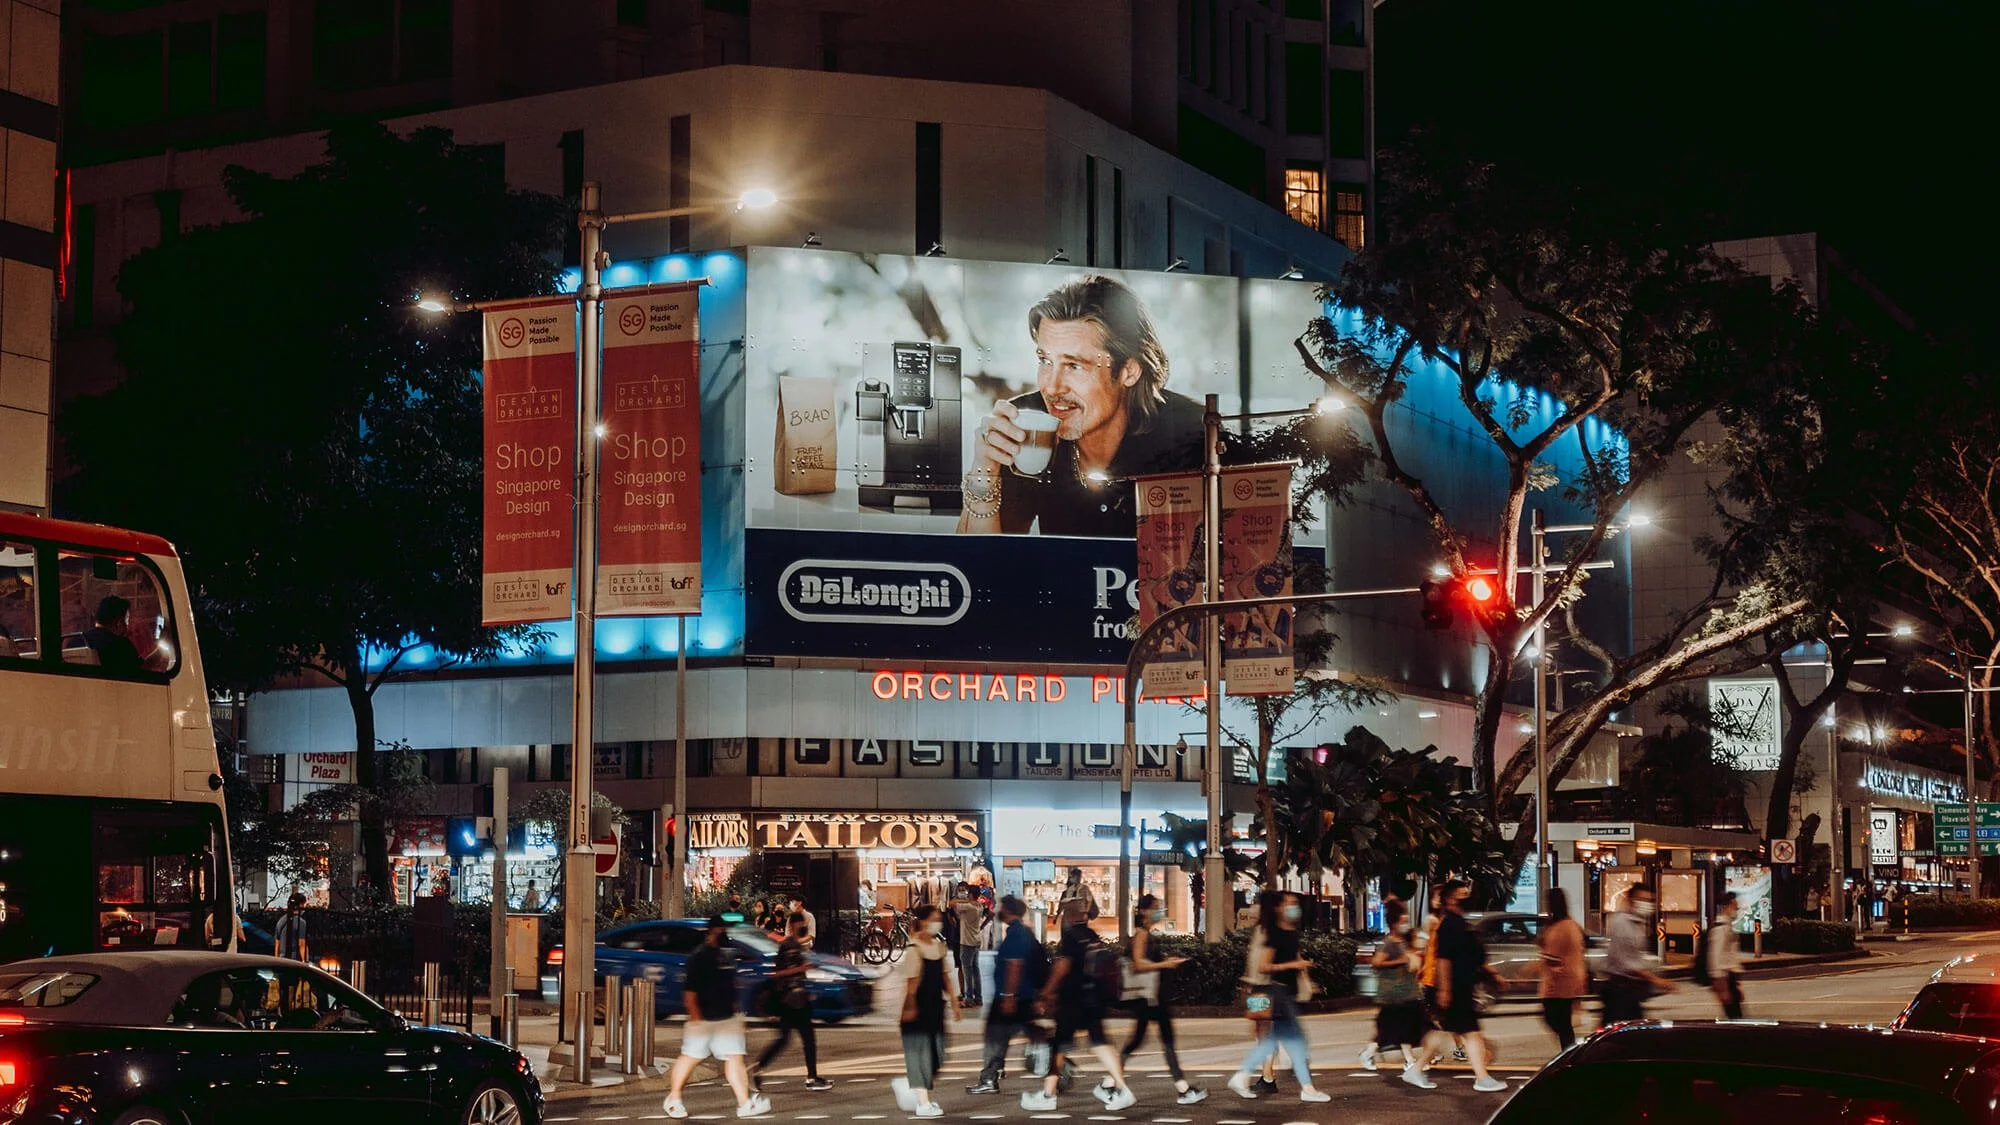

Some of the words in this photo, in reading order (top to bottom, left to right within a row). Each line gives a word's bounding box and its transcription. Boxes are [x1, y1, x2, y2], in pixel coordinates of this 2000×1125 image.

[650, 303, 679, 312] Passion
[529, 316, 558, 326] Passion
[623, 314, 642, 328] SG
[650, 314, 671, 322] Made
[503, 326, 522, 340] SG
[529, 326, 550, 335] Made
[650, 322, 682, 332] Possible
[529, 336, 560, 345] Possible
[619, 384, 681, 397] DESIGN
[500, 394, 559, 408] DESIGN
[619, 395, 681, 408] ORCHARD
[500, 406, 558, 418] ORCHARD
[790, 408, 830, 426] BRAD
[614, 432, 686, 464] Shop
[496, 442, 562, 472] Shop
[614, 470, 686, 488] Singapore
[496, 478, 561, 496] Singapore
[624, 491, 675, 508] Design
[506, 500, 550, 516] Design
[612, 521, 687, 534] designorchard.sg
[1242, 514, 1273, 529] Shop
[1156, 521, 1185, 536] Shop
[496, 529, 560, 543] designorchard.sg
[496, 582, 537, 592] DESIGN
[612, 576, 660, 585] DESIGN
[496, 590, 537, 600] ORCHARD
[612, 584, 660, 593] ORCHARD
[1092, 615, 1128, 639] fro
[872, 671, 1067, 702] ORCHARD
[304, 752, 348, 765] Orchard
[311, 766, 340, 779] Plaza
[1025, 768, 1063, 776] TAILORS
[1074, 768, 1122, 776] MENSWEAR
[780, 814, 860, 822] EHKAY
[690, 820, 749, 848] AILORS
[756, 820, 980, 848] TAILORS
[1058, 824, 1082, 838] The
